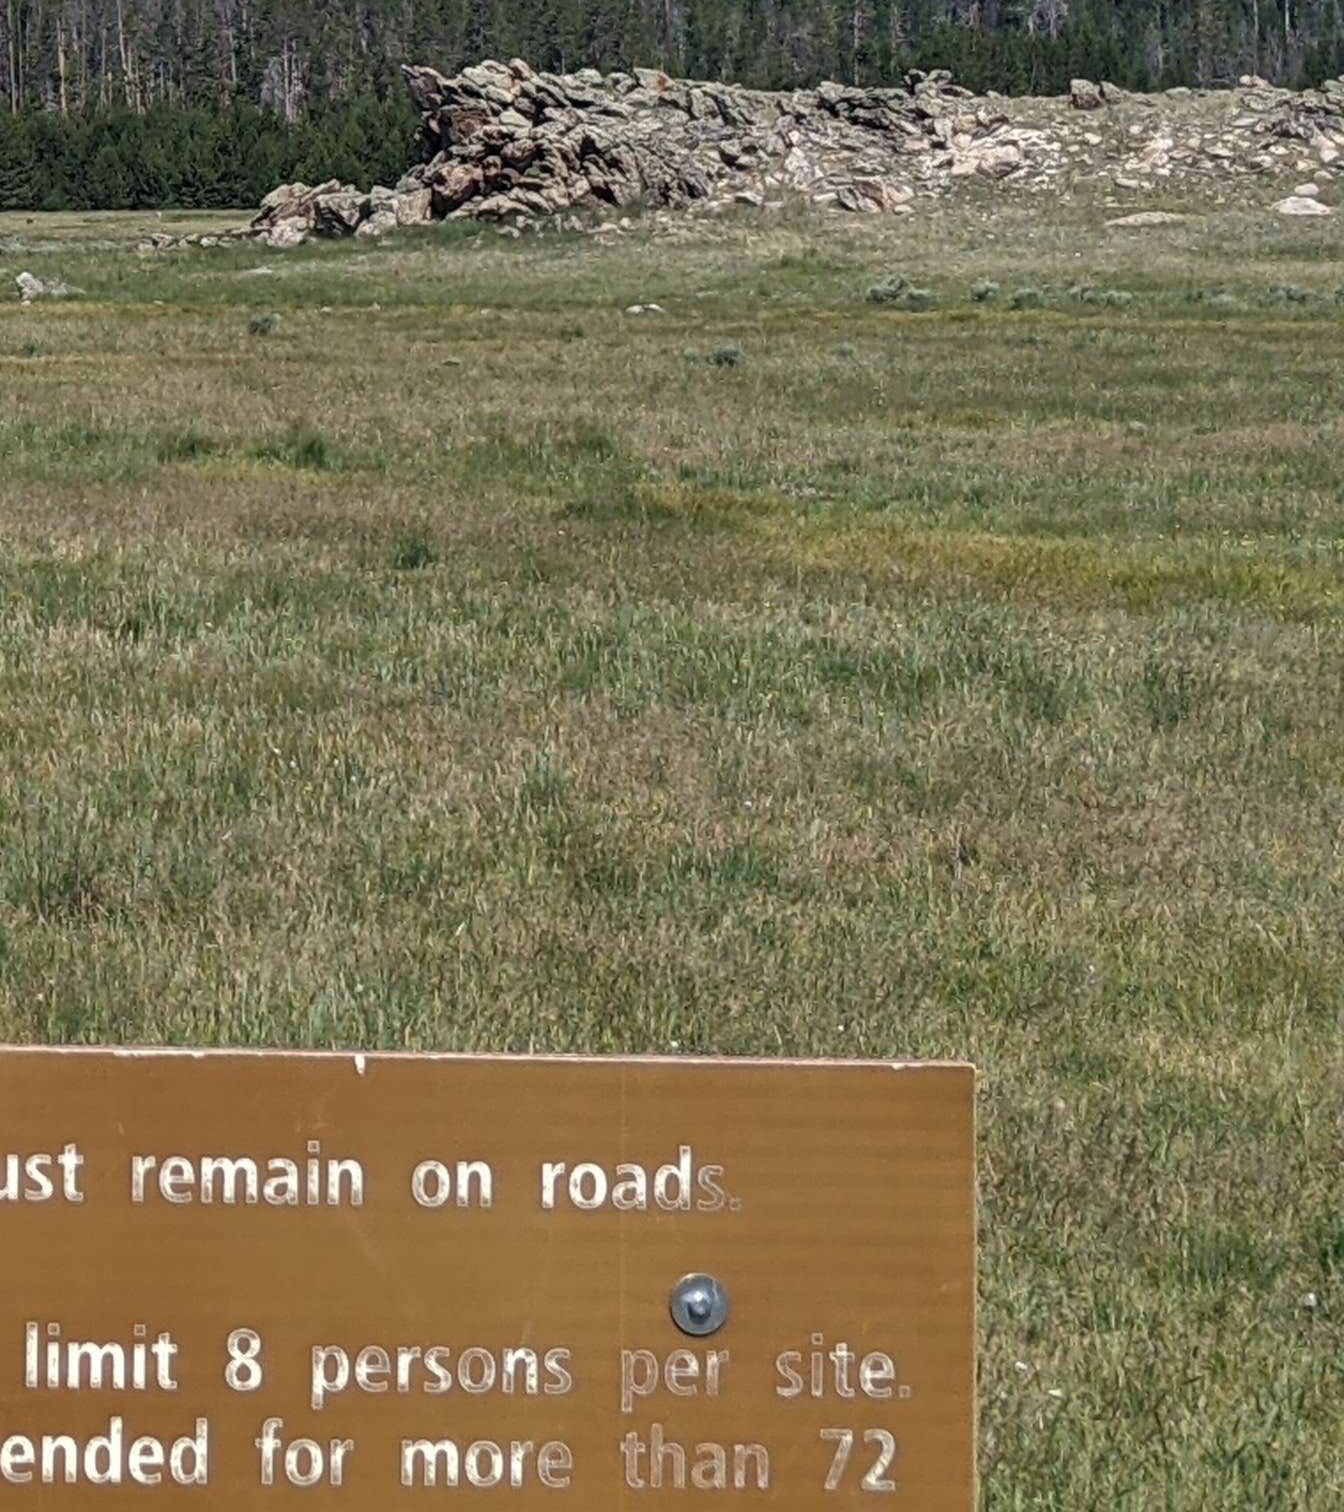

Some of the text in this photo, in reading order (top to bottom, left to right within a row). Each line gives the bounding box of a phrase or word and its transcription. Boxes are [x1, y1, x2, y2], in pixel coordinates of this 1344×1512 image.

[131, 1140, 364, 1205] remain
[411, 1159, 493, 1208] on
[540, 1145, 742, 1211] roads.
[25, 1322, 177, 1390] limit
[224, 1328, 263, 1391] 8
[311, 1343, 573, 1409] persons
[620, 1346, 729, 1412] per
[776, 1332, 911, 1398] site.
[256, 1417, 354, 1486] for
[401, 1437, 573, 1488] more
[621, 1423, 770, 1489] than
[820, 1427, 896, 1492] 72
